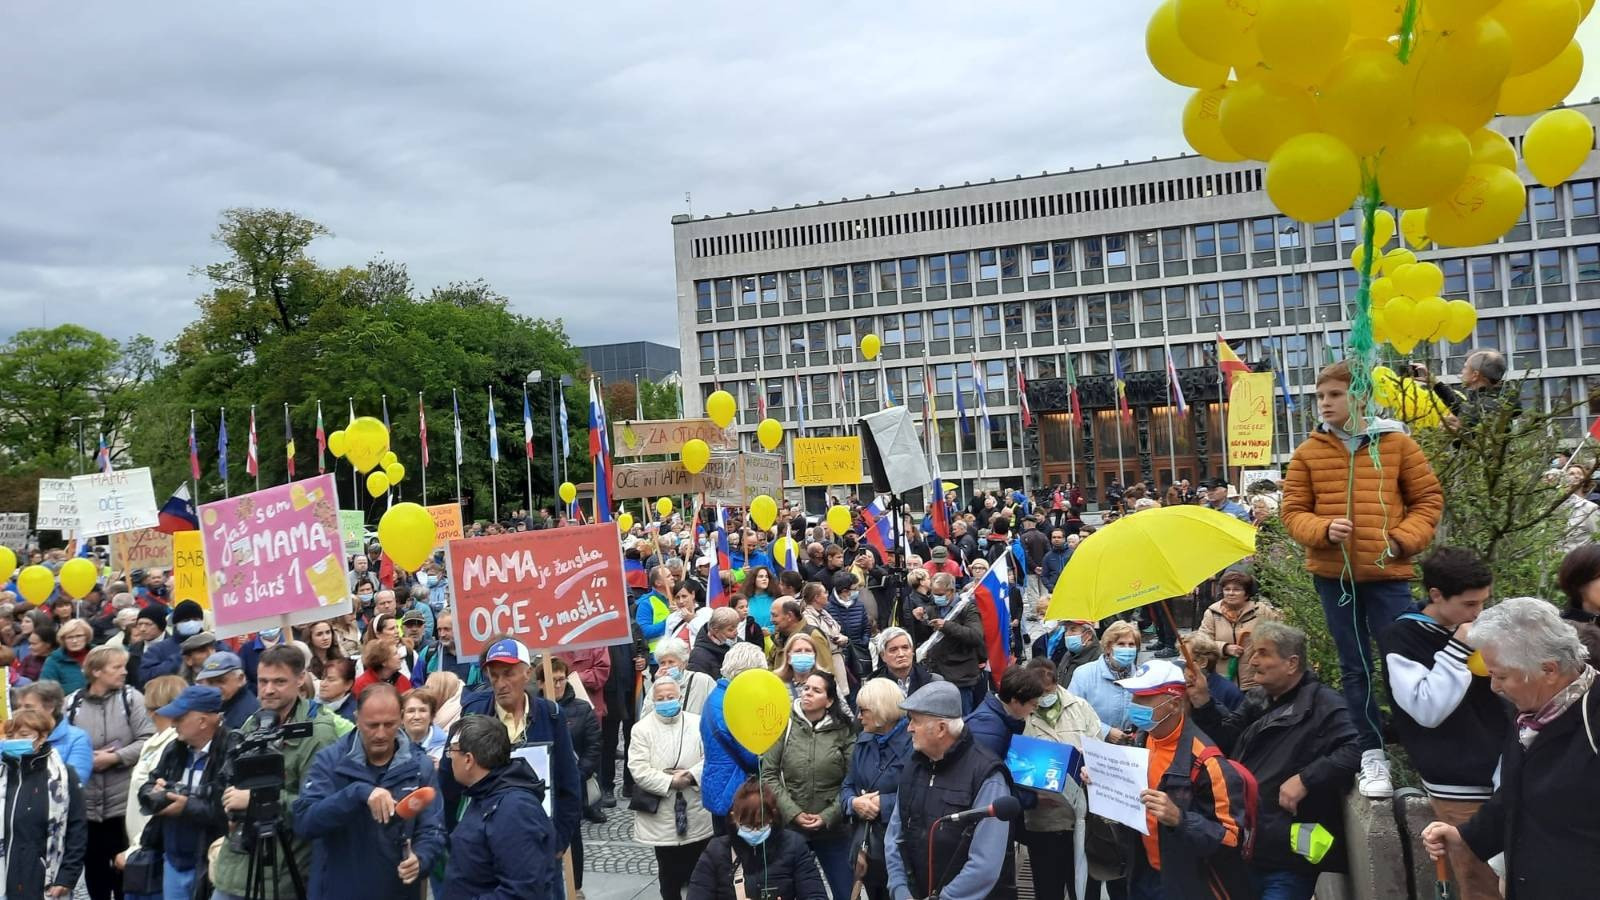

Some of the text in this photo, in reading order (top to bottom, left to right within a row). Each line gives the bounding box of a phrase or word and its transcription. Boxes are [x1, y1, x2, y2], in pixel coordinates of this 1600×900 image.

[650, 427, 668, 444] ZA
[91, 474, 128, 487] MAMA
[616, 468, 639, 488] OČE
[98, 496, 125, 512] OČE
[255, 500, 291, 524] sem
[97, 516, 139, 535] OTROK
[177, 550, 204, 568] BAB
[462, 545, 603, 591] MAMA je ženska
[180, 572, 193, 589] IN
[223, 592, 239, 607] ne
[245, 570, 285, 604] starš
[288, 557, 303, 595] 1
[591, 574, 608, 588] in
[469, 593, 531, 642] OČE
[535, 611, 553, 641] je
